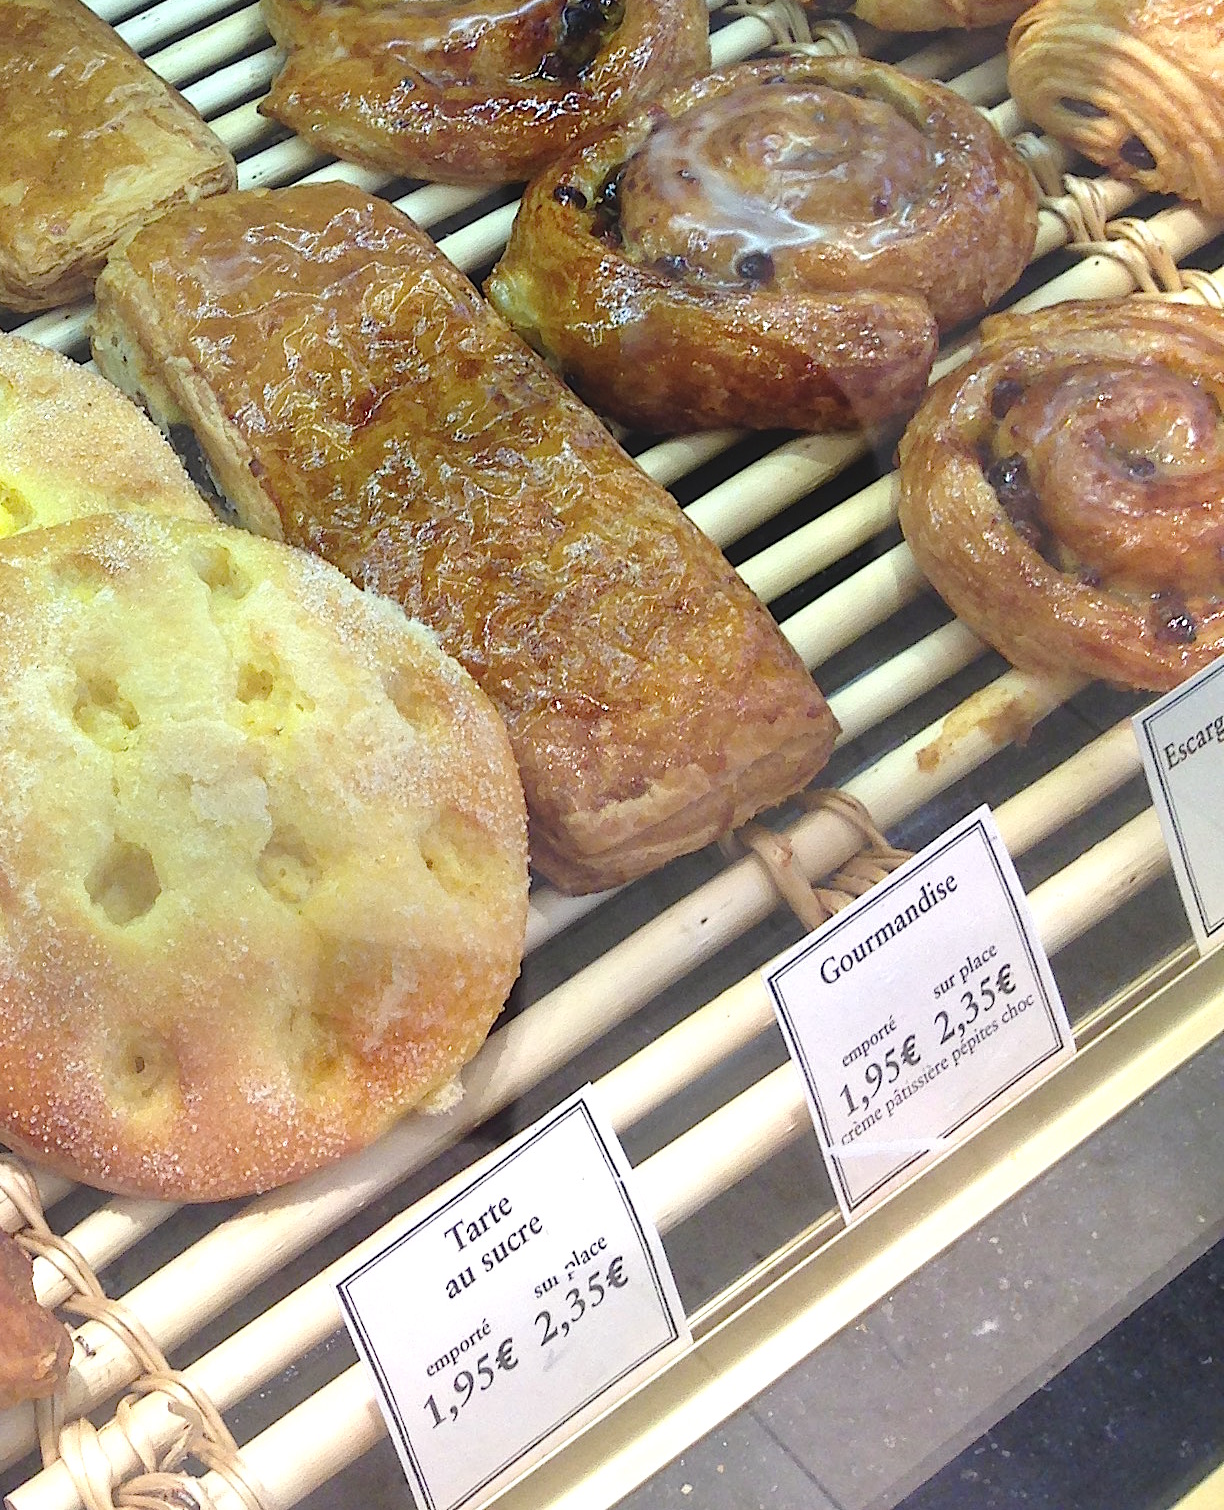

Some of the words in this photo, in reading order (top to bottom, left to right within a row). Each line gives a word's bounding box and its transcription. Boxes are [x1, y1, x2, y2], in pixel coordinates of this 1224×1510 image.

[819, 872, 958, 985] Gourmandise
[839, 1035, 922, 1117] 1,95€
[933, 964, 1017, 1046] 2,35€
[842, 1014, 898, 1067] emporté
[933, 977, 956, 1000] sur
[959, 943, 998, 988] place
[841, 1107, 883, 1146] crème
[885, 1057, 950, 1118] pâtissière
[951, 1019, 999, 1066] pépites
[1001, 993, 1035, 1024] choc
[443, 1194, 514, 1254] Tarte
[445, 1264, 476, 1301] au
[481, 1214, 544, 1273] sucre
[422, 1337, 519, 1430] 1,95€
[534, 1256, 629, 1347] 2,35€
[426, 1318, 491, 1378] emporté
